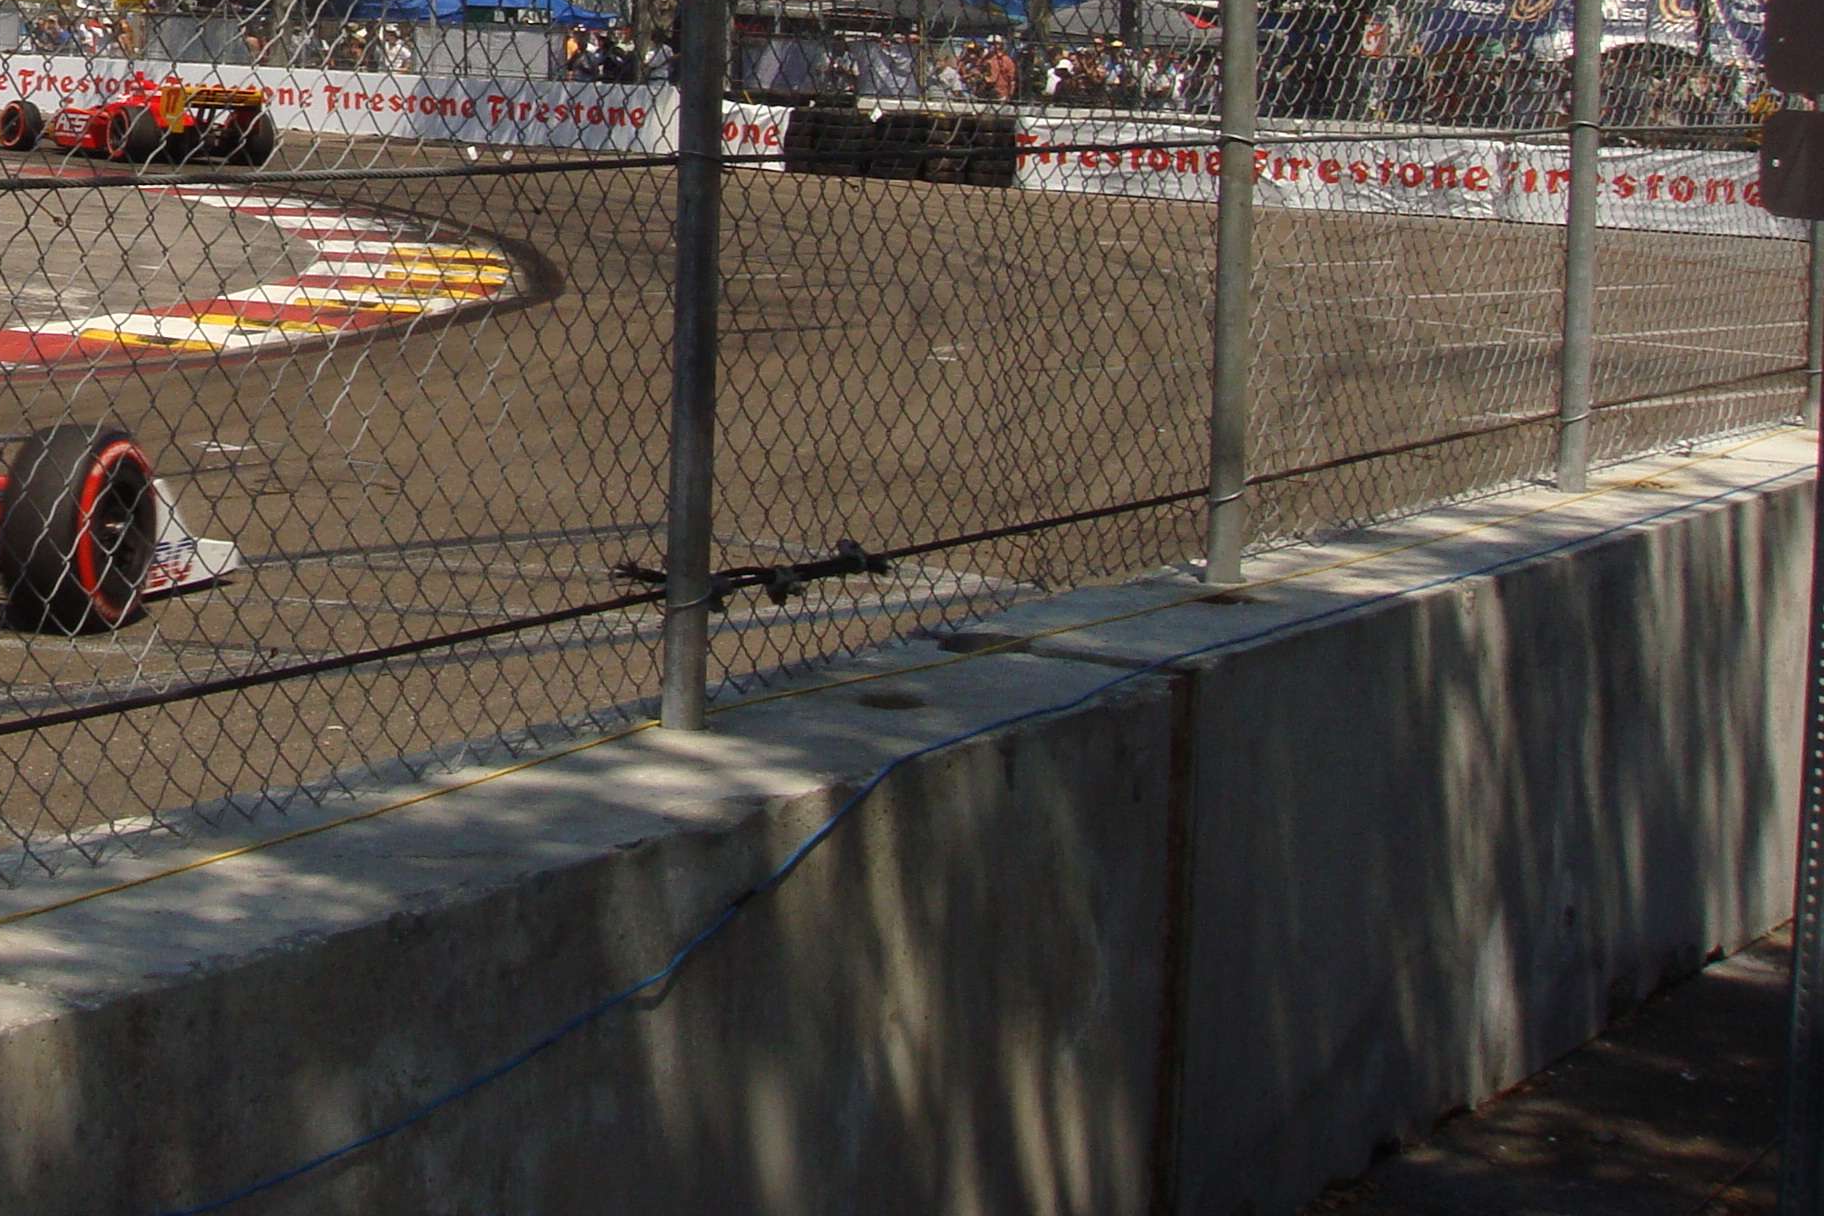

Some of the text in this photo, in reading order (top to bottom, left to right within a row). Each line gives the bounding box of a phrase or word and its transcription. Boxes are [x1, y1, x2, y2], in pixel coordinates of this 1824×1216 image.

[323, 84, 476, 119] Firestone
[487, 94, 647, 137] Firestone
[1014, 132, 1223, 176] Firestone
